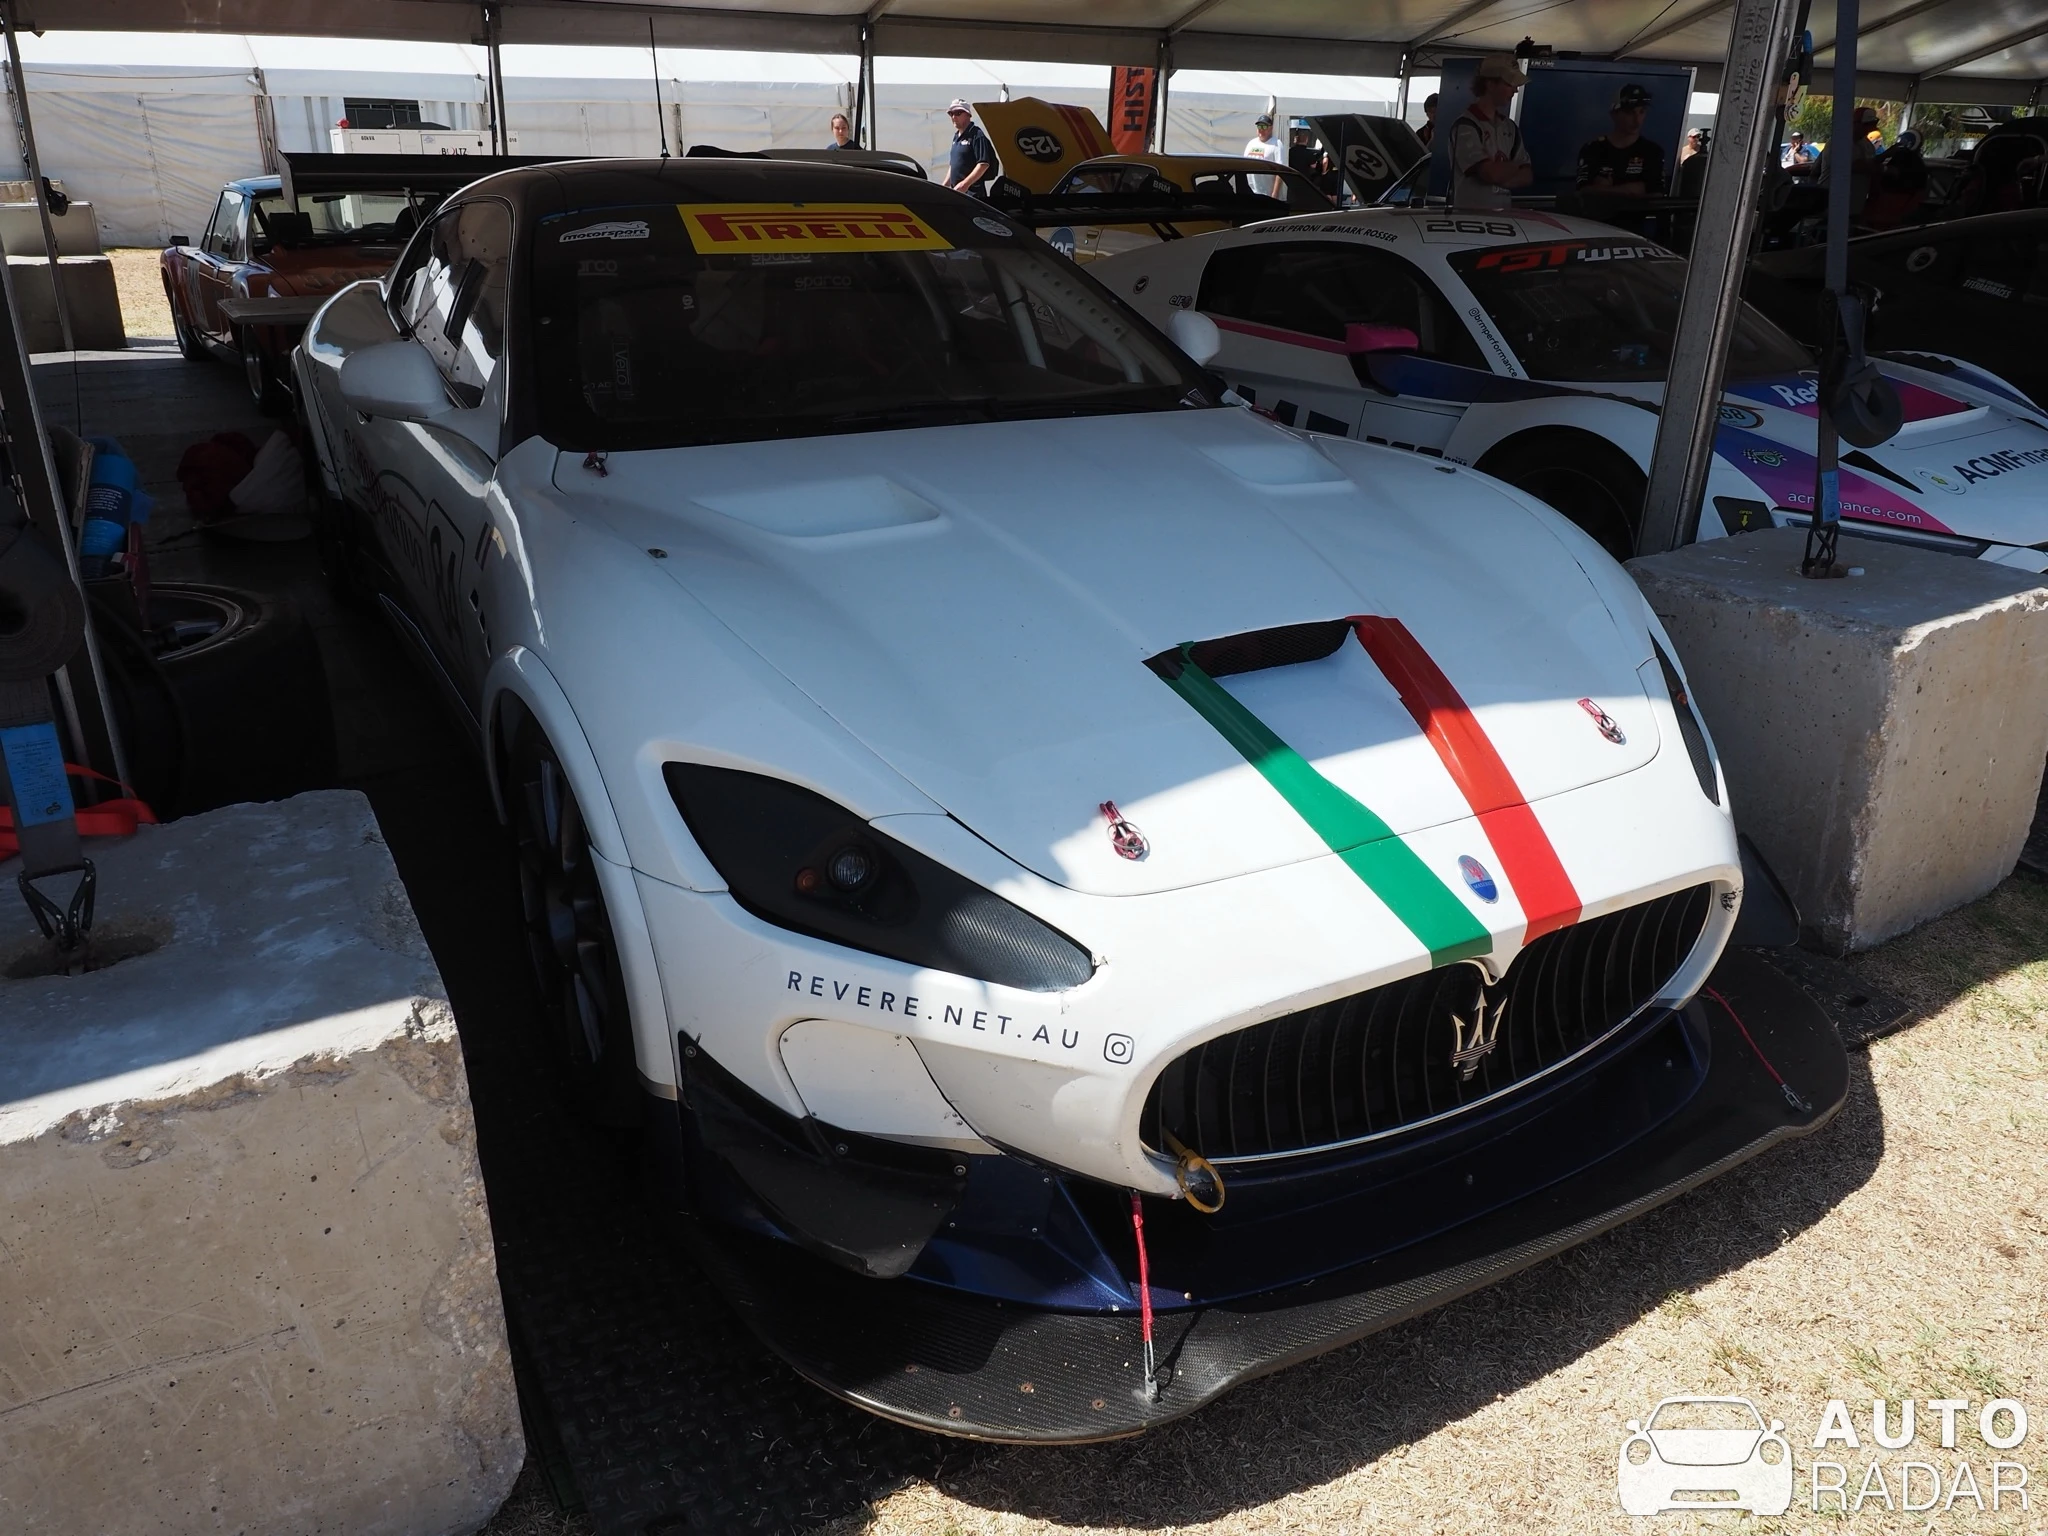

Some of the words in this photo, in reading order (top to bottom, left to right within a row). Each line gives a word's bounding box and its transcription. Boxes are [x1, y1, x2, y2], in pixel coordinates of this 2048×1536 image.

[1744, 58, 1763, 94] Hire
[1018, 136, 1060, 155] 125
[1003, 183, 1021, 198] BRM
[1153, 179, 1171, 194] BRM
[563, 229, 647, 241] motorsport
[694, 213, 928, 242] PIRELLI
[1265, 225, 1287, 233] ALEX
[1335, 226, 1364, 235] MARK
[1364, 228, 1398, 243] ROSSER
[1426, 219, 1517, 237] 268
[1476, 244, 1587, 273] GT
[794, 275, 852, 291] sparco
[1468, 307, 1517, 378] @brmperformance
[787, 970, 1079, 1049] REVERE.NET.AU
